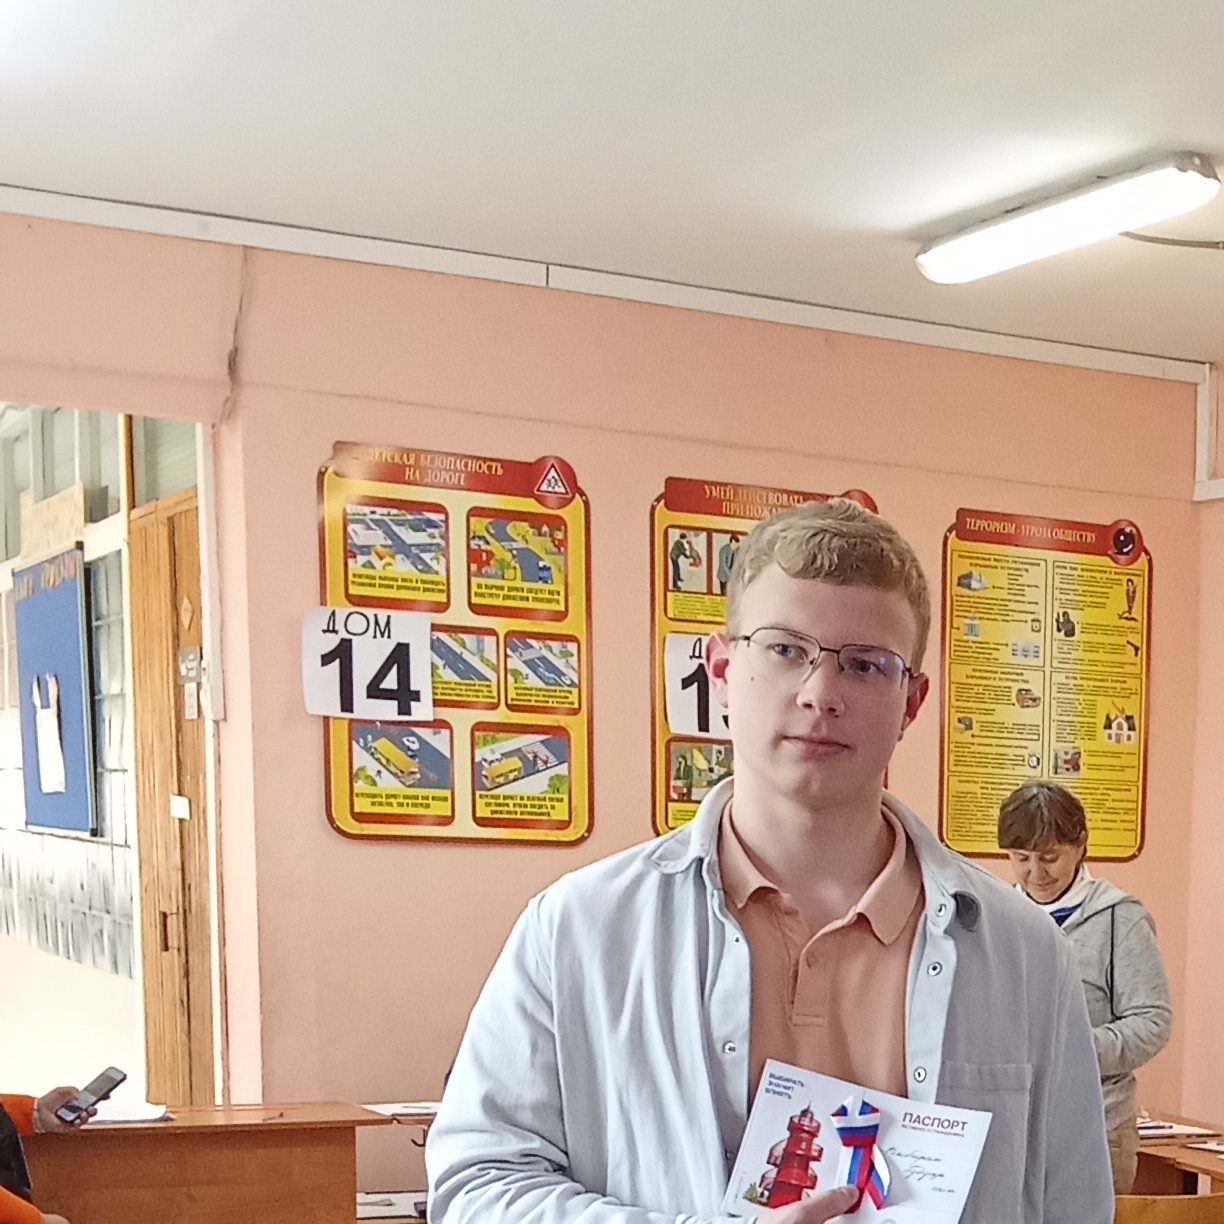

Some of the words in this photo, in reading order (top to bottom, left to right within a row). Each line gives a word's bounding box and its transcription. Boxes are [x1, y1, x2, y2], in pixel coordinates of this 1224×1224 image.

[420, 454, 504, 475] БЕЗОПАСНОСТЬ
[405, 467, 420, 480] НА
[424, 470, 467, 486] ДОРОГЕ
[704, 485, 734, 500] УМЕЙ
[722, 501, 744, 516] ПРИ
[966, 517, 1017, 535] ТЕРРОРИЗМ
[1052, 527, 1096, 544] ОБЩЕСТВУ
[321, 609, 392, 639] ДОМ
[320, 637, 421, 717] 14
[902, 1112, 968, 1131] ПАСПОРТ
